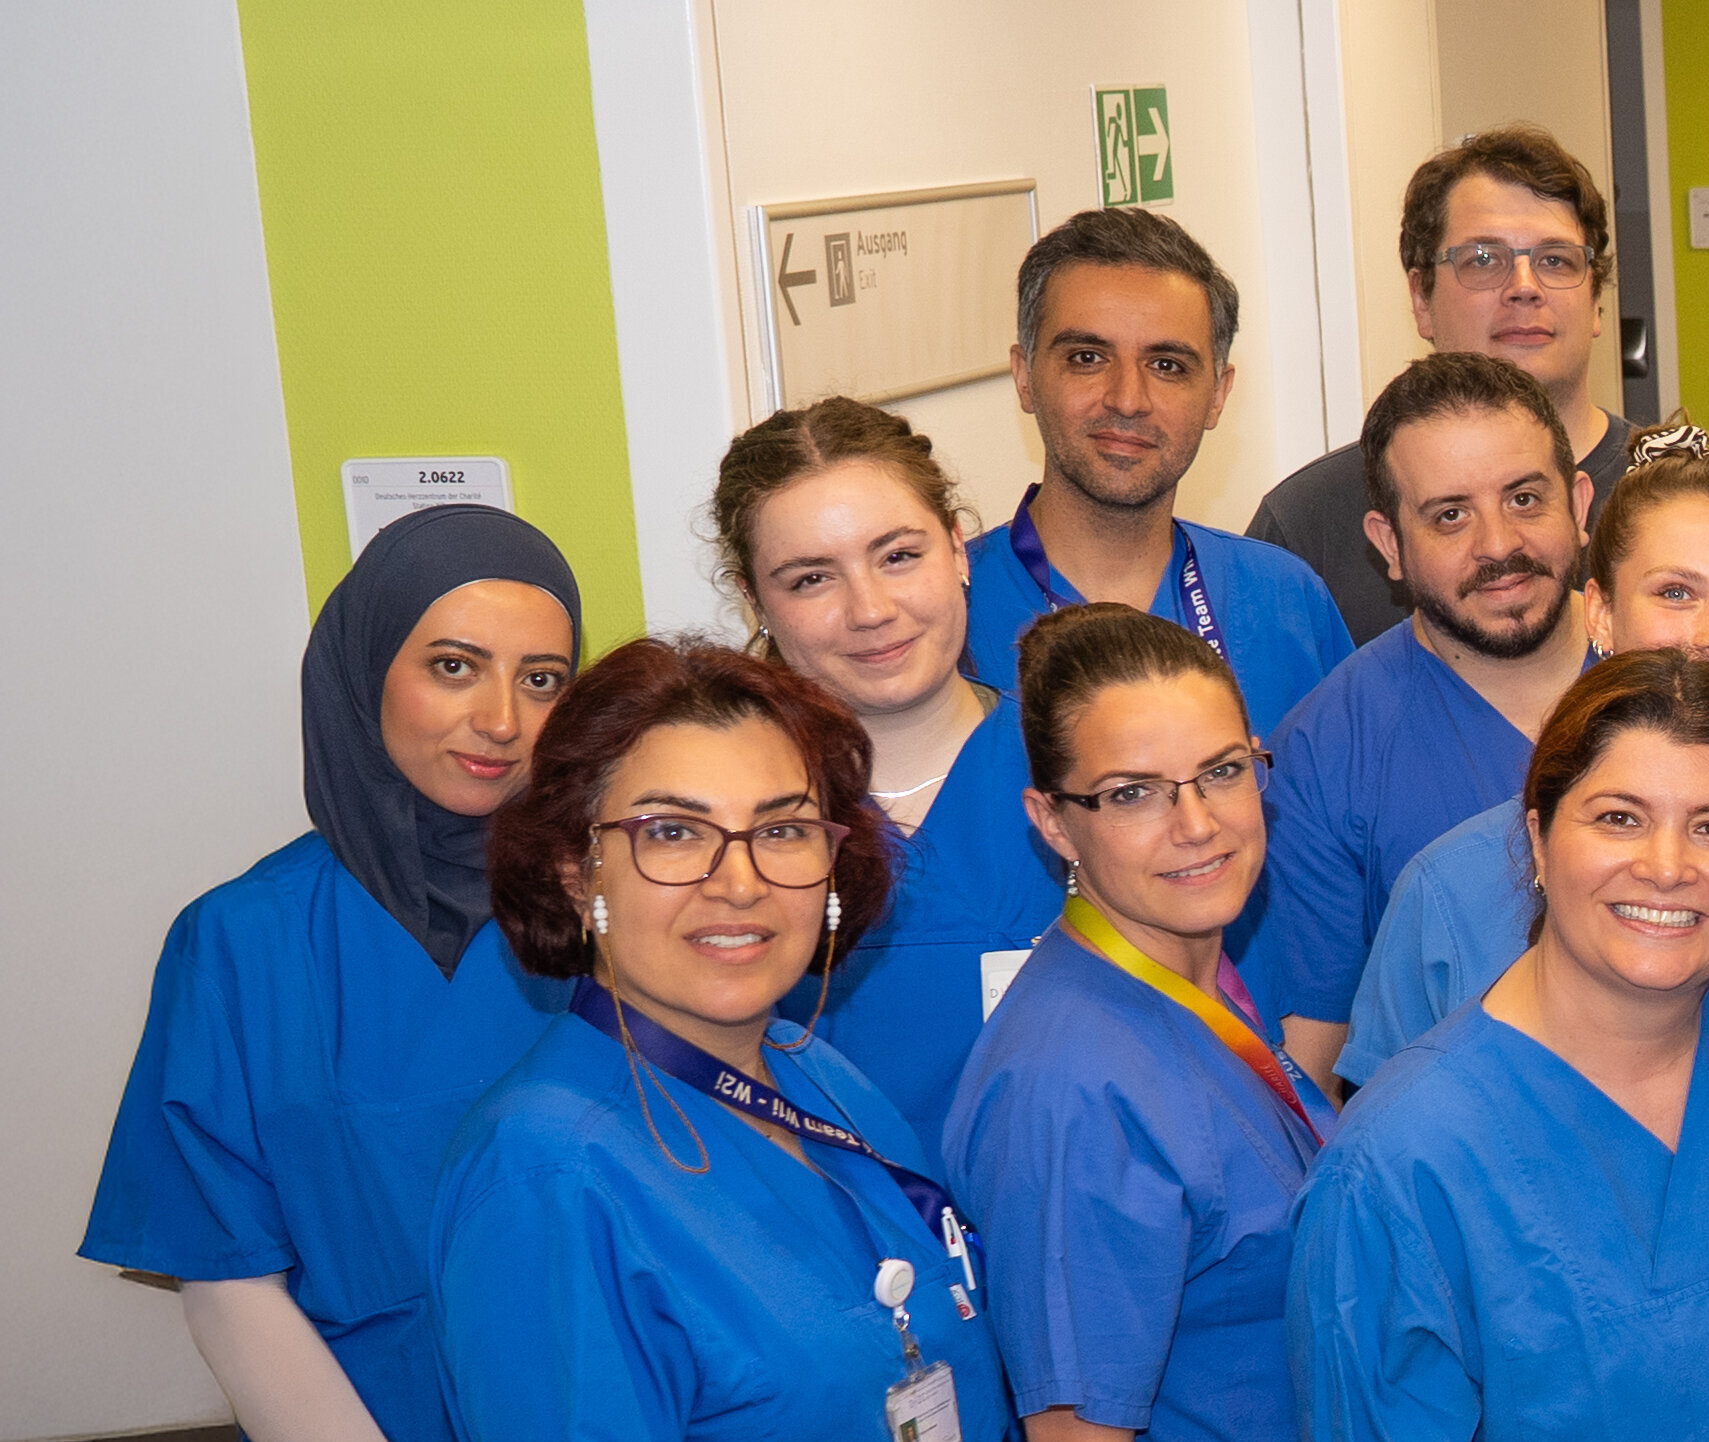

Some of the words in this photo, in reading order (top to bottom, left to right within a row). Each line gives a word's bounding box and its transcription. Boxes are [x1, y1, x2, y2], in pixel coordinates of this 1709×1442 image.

[857, 230, 908, 259] Ausgang
[859, 268, 877, 290] Exit
[418, 471, 465, 483] 2.0622
[1190, 588, 1214, 637] Team
[713, 1070, 752, 1106] W2i
[804, 1117, 861, 1149] Team
